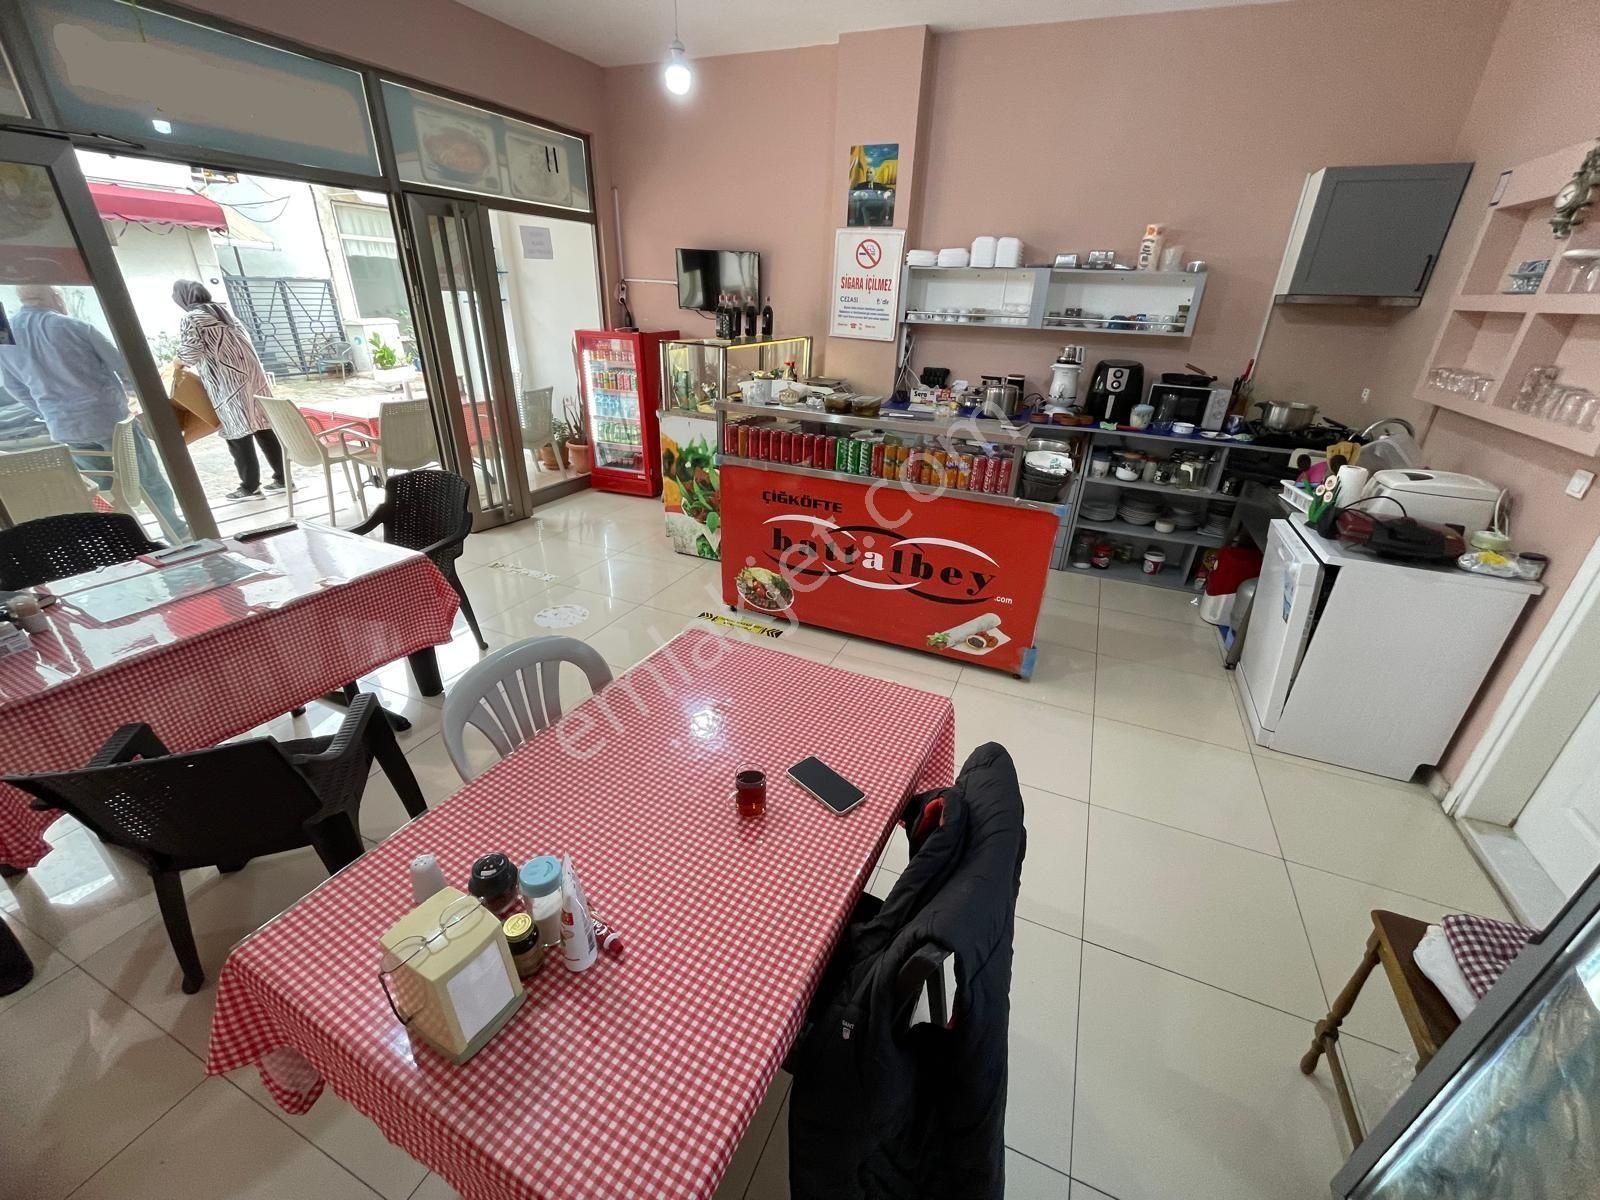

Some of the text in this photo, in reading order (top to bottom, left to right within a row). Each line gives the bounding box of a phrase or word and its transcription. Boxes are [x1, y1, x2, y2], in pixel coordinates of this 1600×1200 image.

[840, 273, 893, 294] SİGARA İÇİLMEZ
[761, 490, 843, 513] ÇİĞKÖFTE
